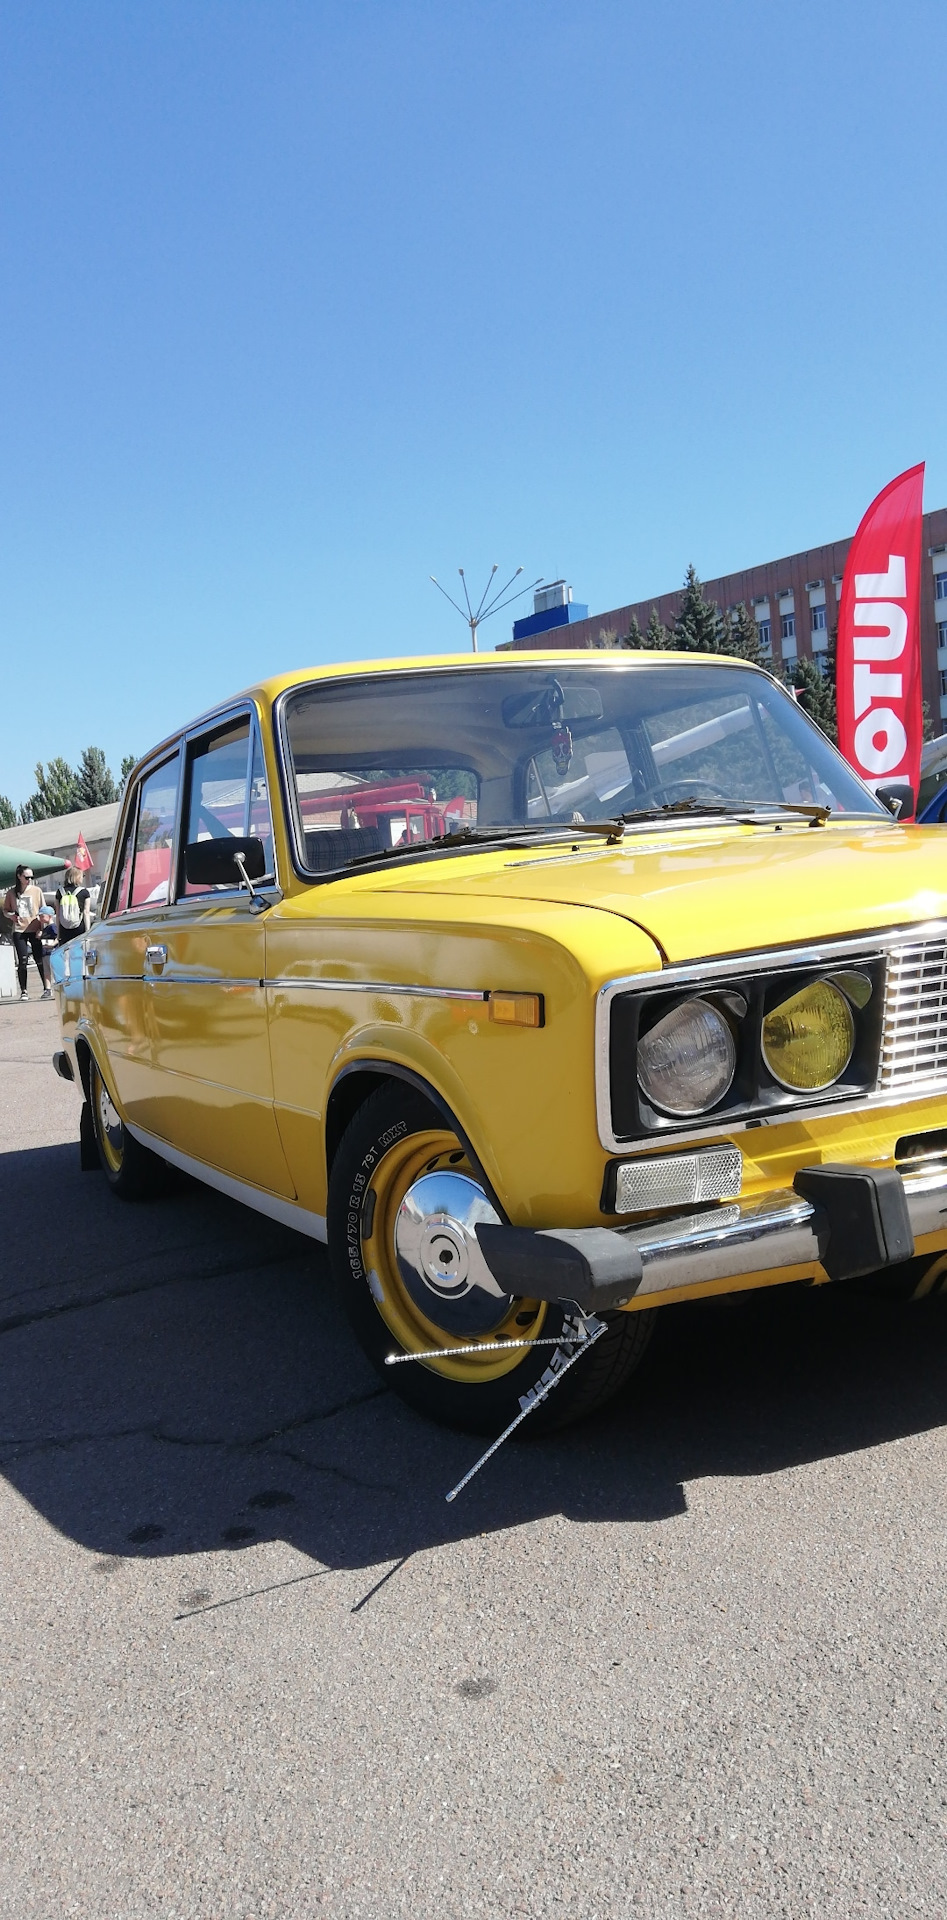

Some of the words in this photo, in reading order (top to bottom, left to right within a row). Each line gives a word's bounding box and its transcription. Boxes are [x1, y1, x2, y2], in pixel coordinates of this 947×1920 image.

[378, 1120, 408, 1148] MXT
[361, 1145, 379, 1170] 79T
[352, 1172, 366, 1192] 13
[349, 1194, 361, 1209] R
[347, 1211, 363, 1280] 165/70
